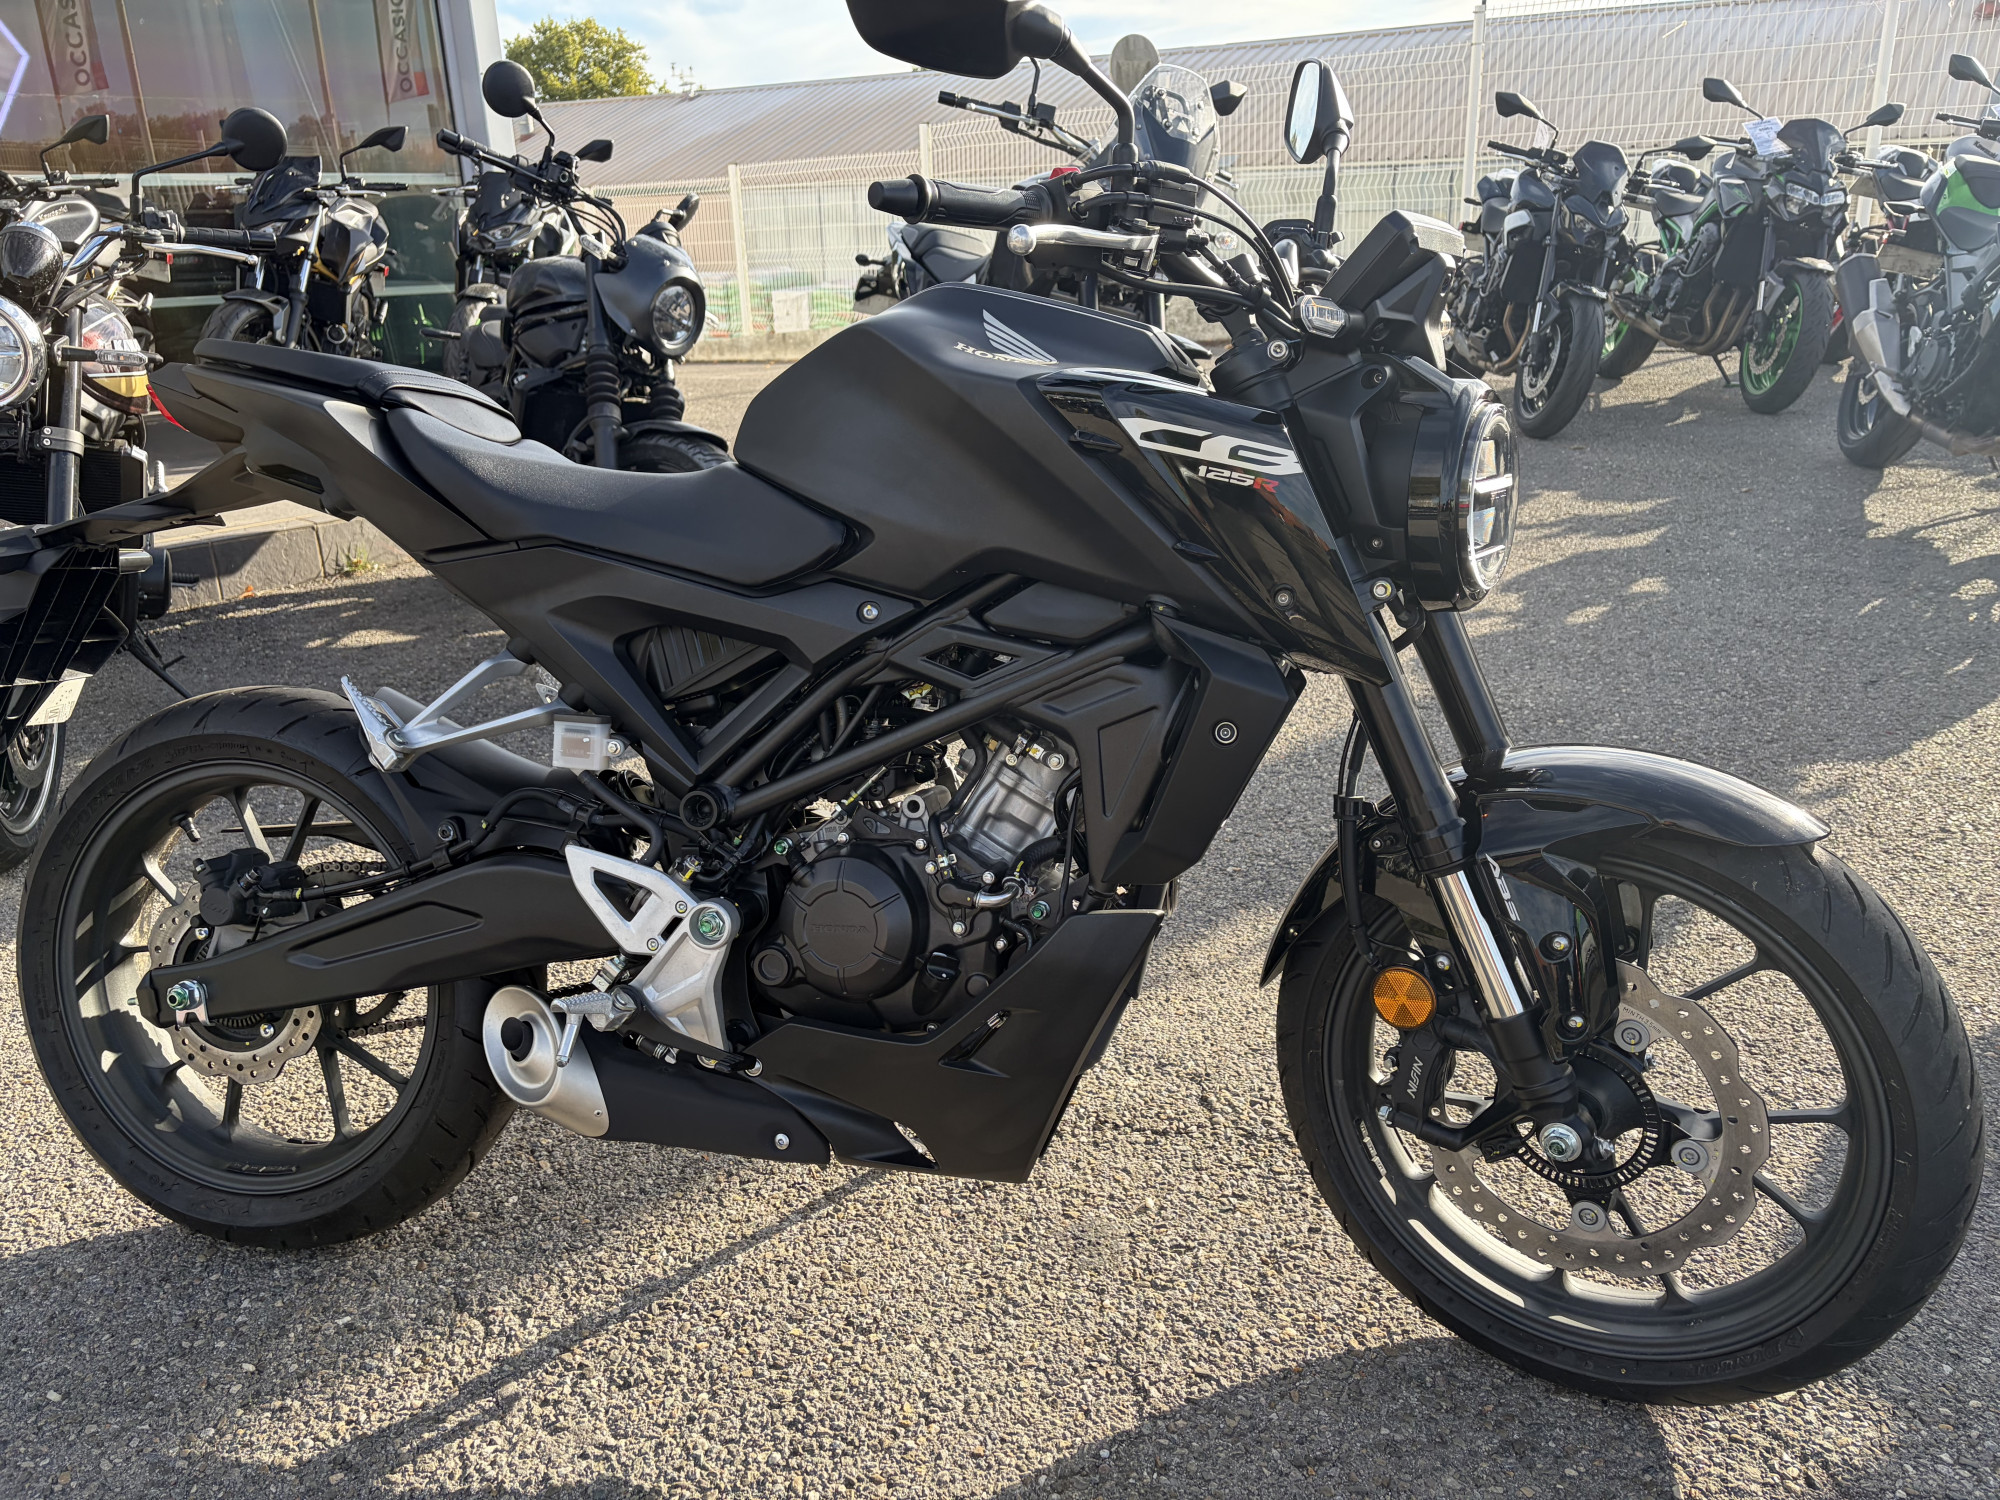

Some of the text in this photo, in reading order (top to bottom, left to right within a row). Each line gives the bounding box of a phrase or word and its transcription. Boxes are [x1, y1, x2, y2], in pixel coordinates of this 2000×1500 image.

[1118, 417, 1303, 476] CB
[1198, 465, 1279, 493] 125R
[1485, 853, 1520, 921] ABS
[809, 923, 870, 936] HONDA
